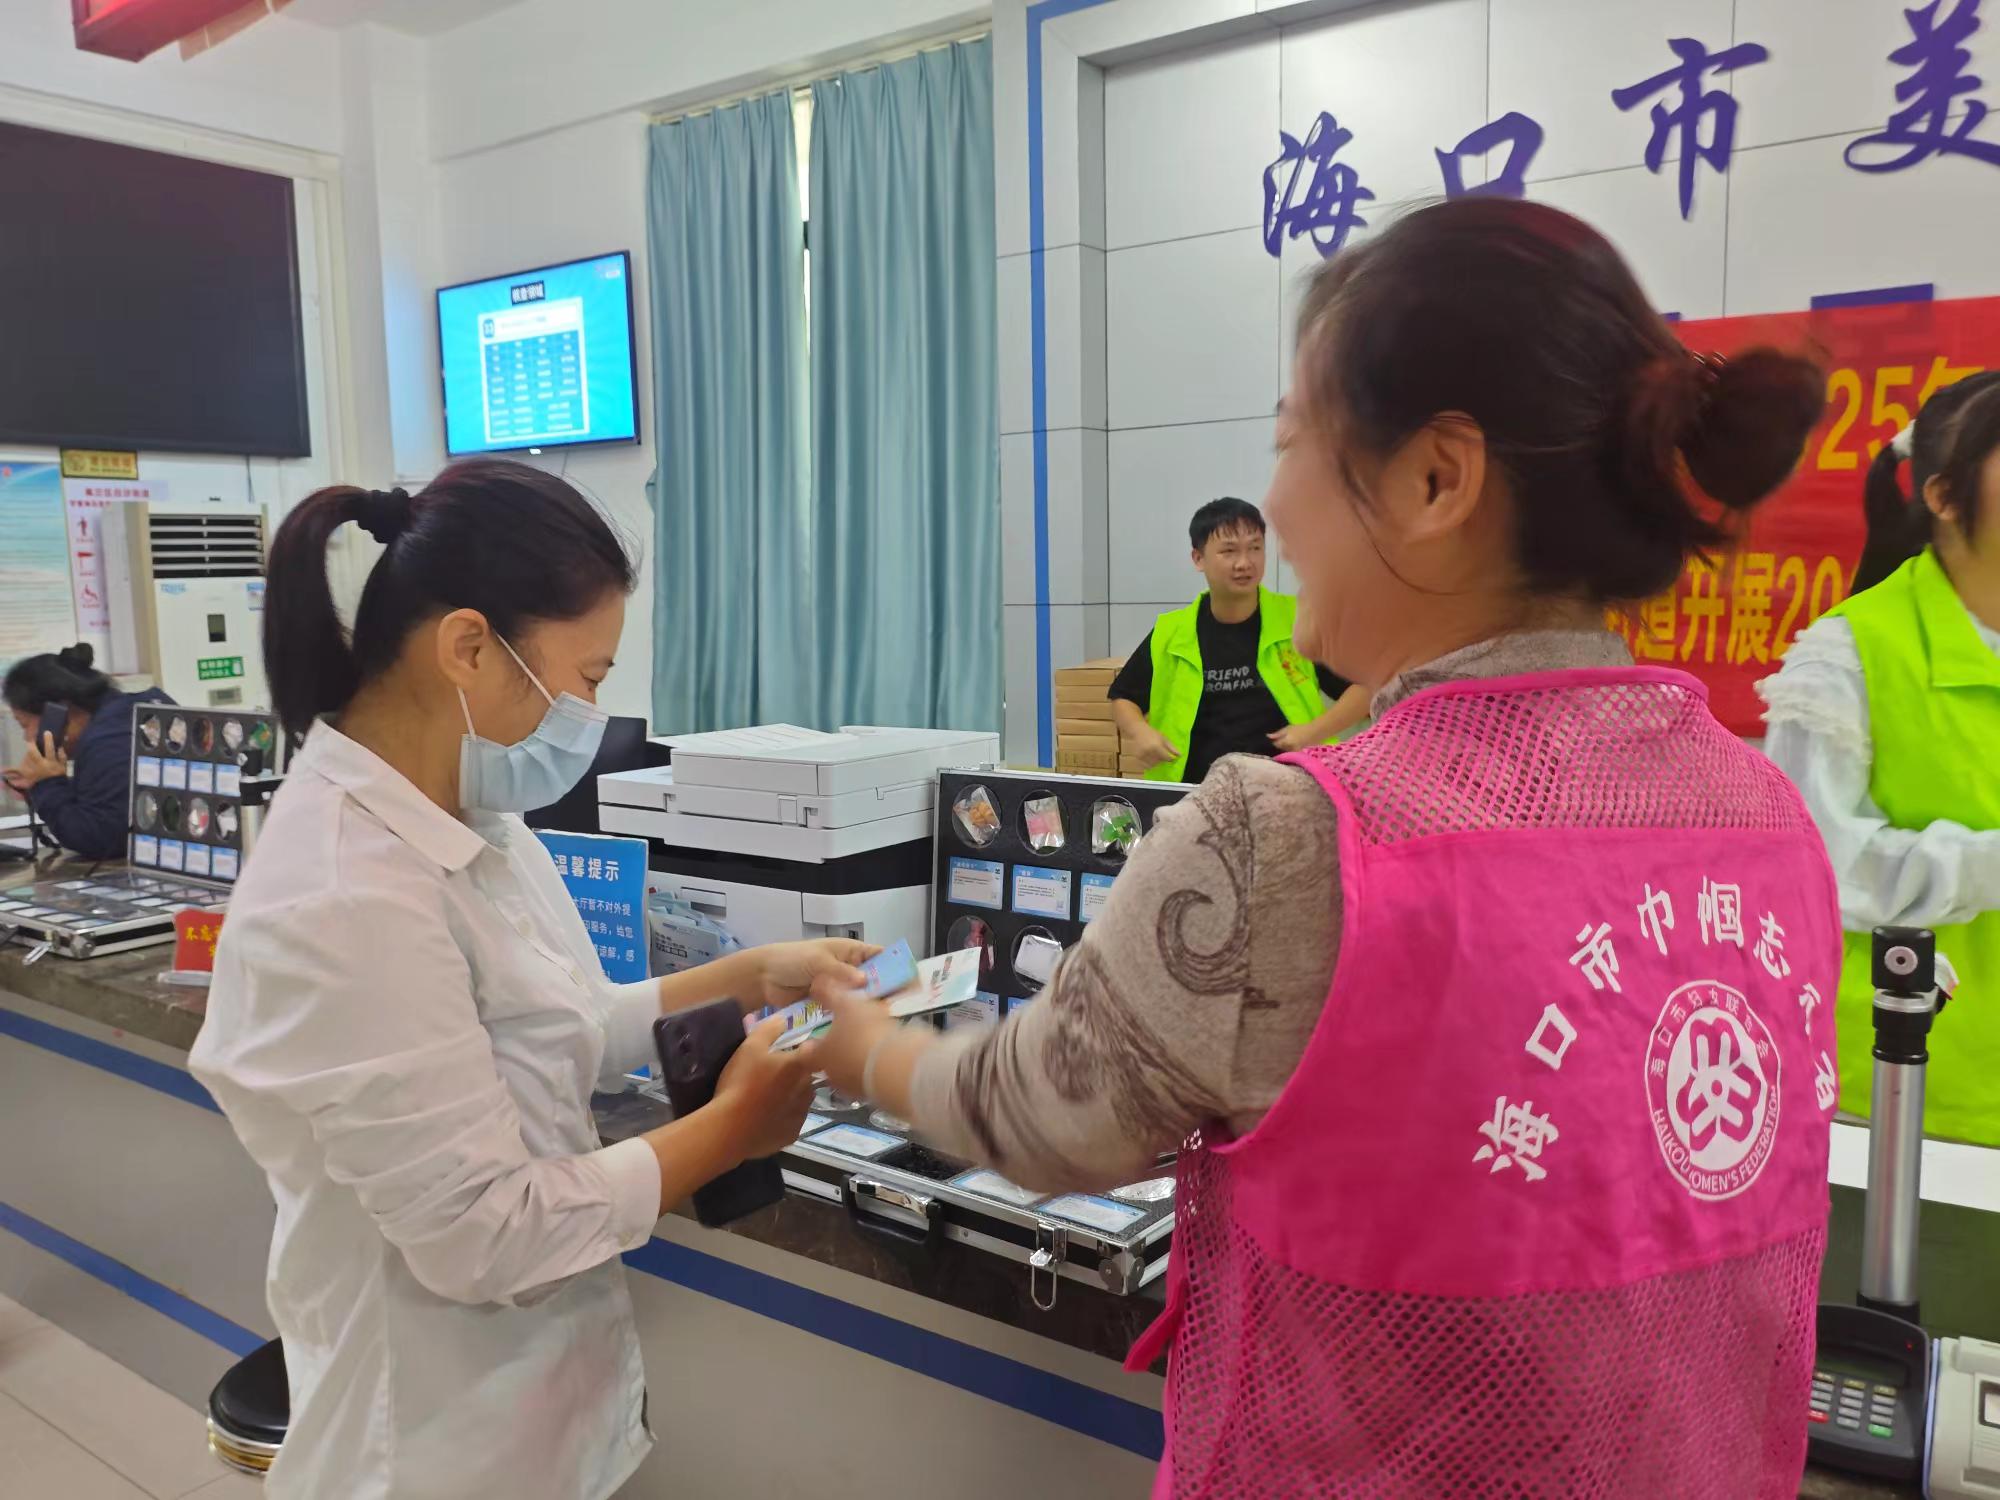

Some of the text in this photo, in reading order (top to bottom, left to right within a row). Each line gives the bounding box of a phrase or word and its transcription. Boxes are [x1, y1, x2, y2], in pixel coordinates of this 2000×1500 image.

[1604, 553, 1860, 666] 道开展20
[1204, 666, 1250, 681] RIEND
[554, 854, 619, 881] 温馨提示
[1653, 1108, 1691, 1174] HAIKOU
[1688, 1168, 1739, 1193] OMEN'S
